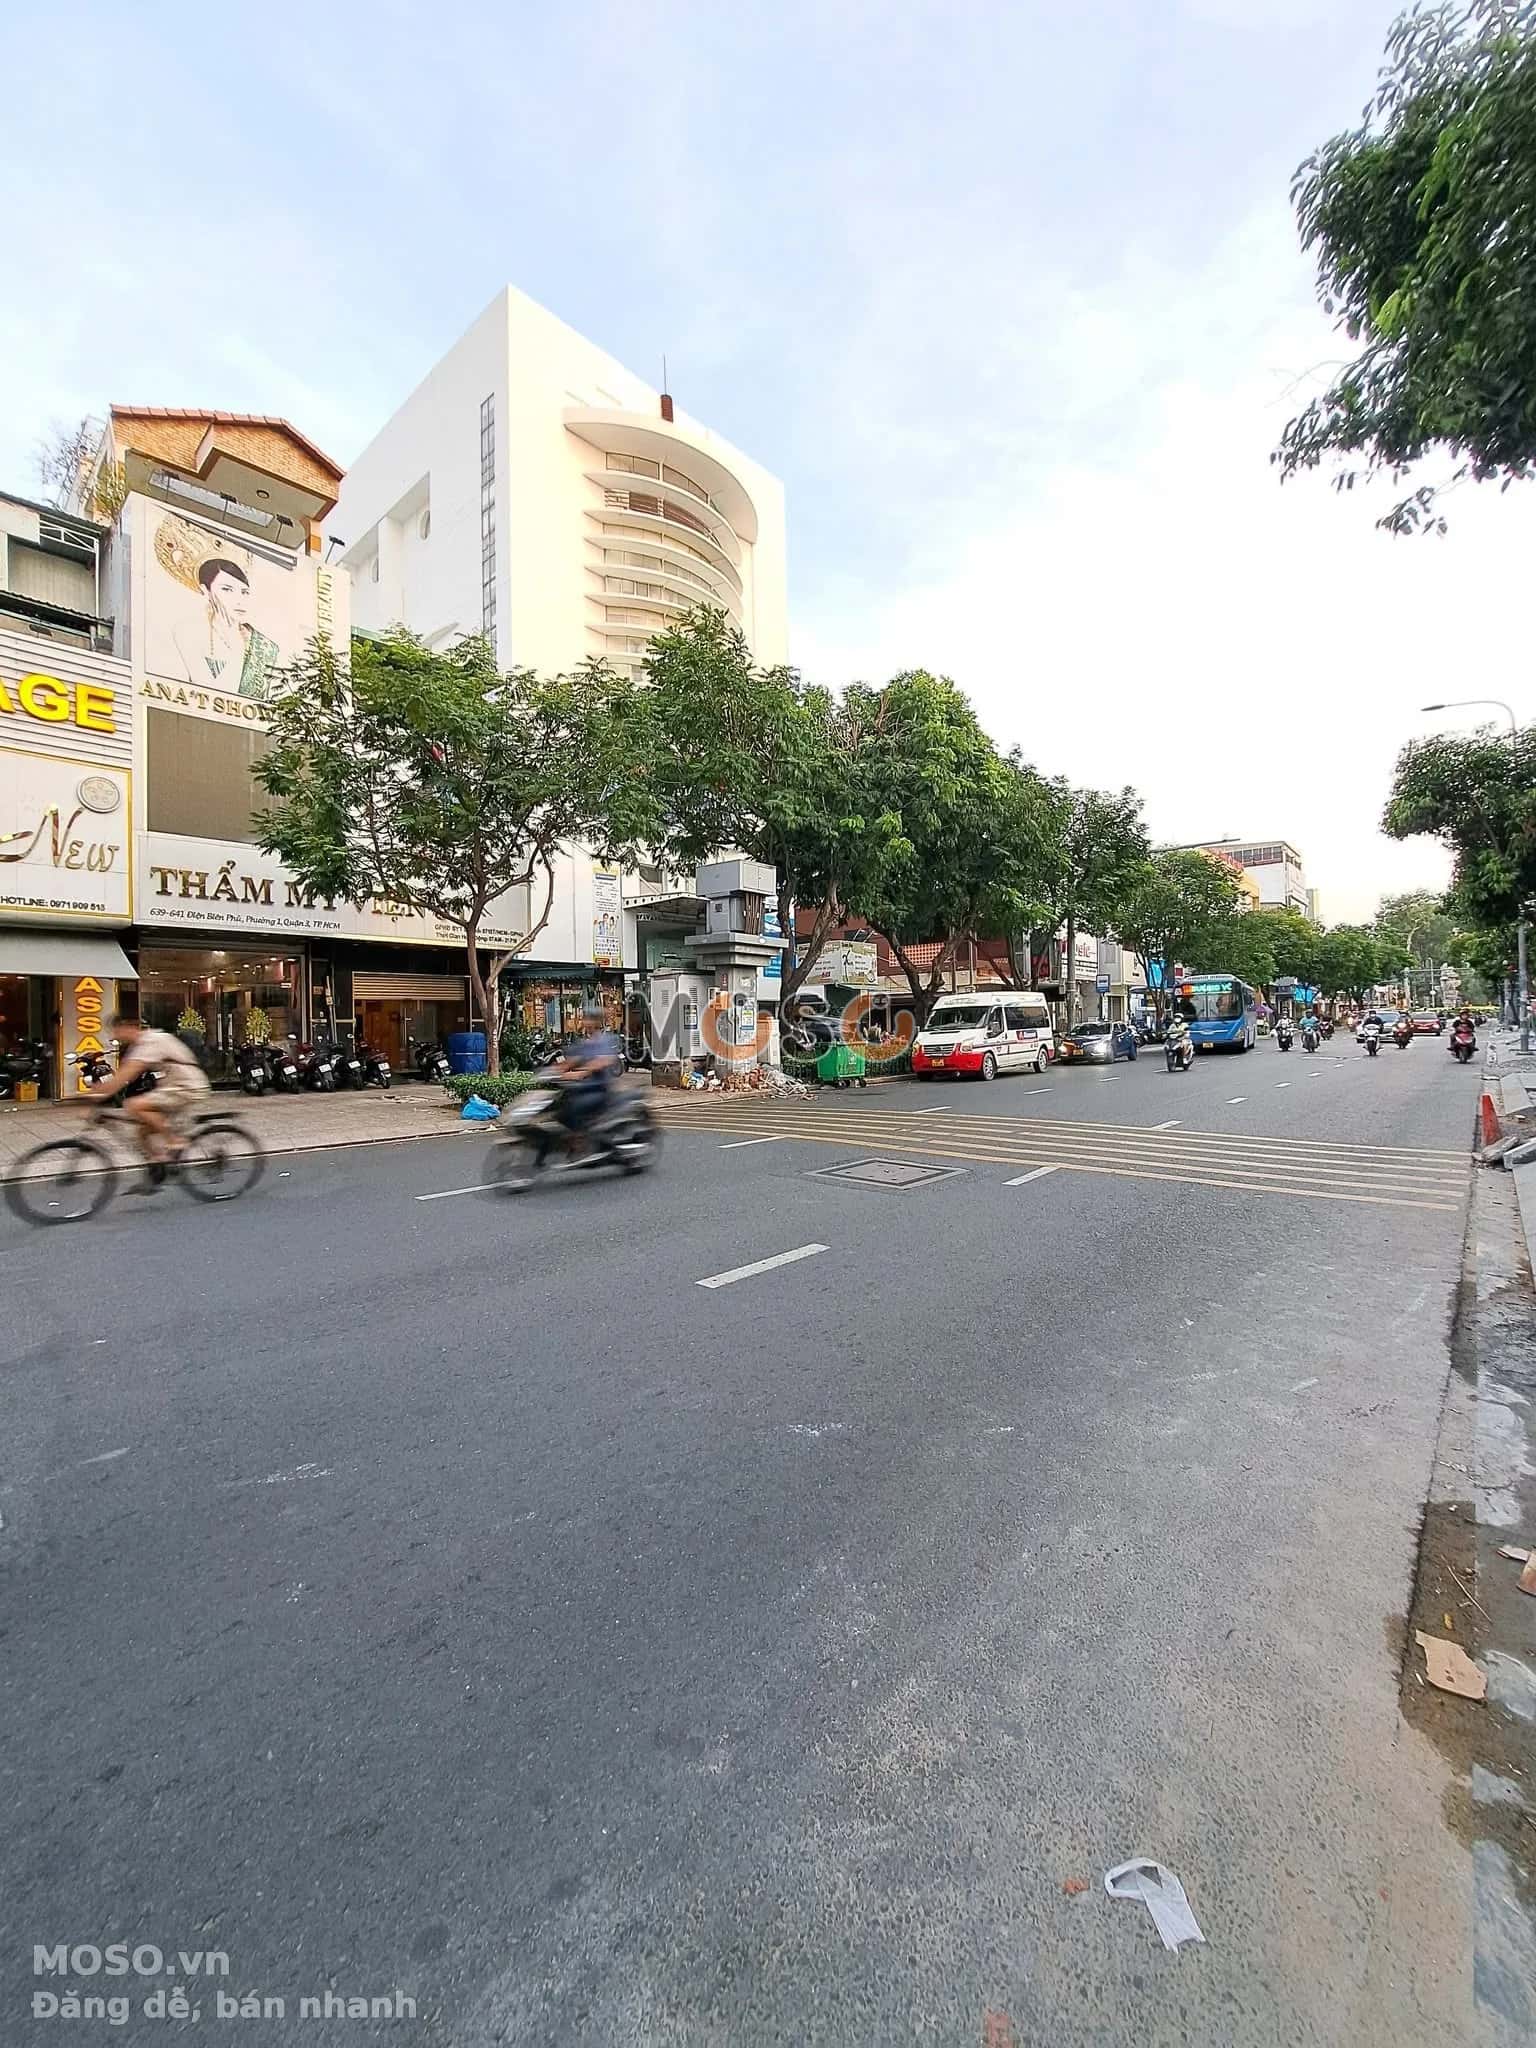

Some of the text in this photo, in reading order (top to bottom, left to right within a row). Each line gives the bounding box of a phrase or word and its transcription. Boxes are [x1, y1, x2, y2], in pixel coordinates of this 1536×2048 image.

[150, 860, 274, 905] THẨM
[1, 896, 48, 907] HOTLINE:
[50, 900, 71, 909] 0971
[150, 908, 185, 918] 639-641
